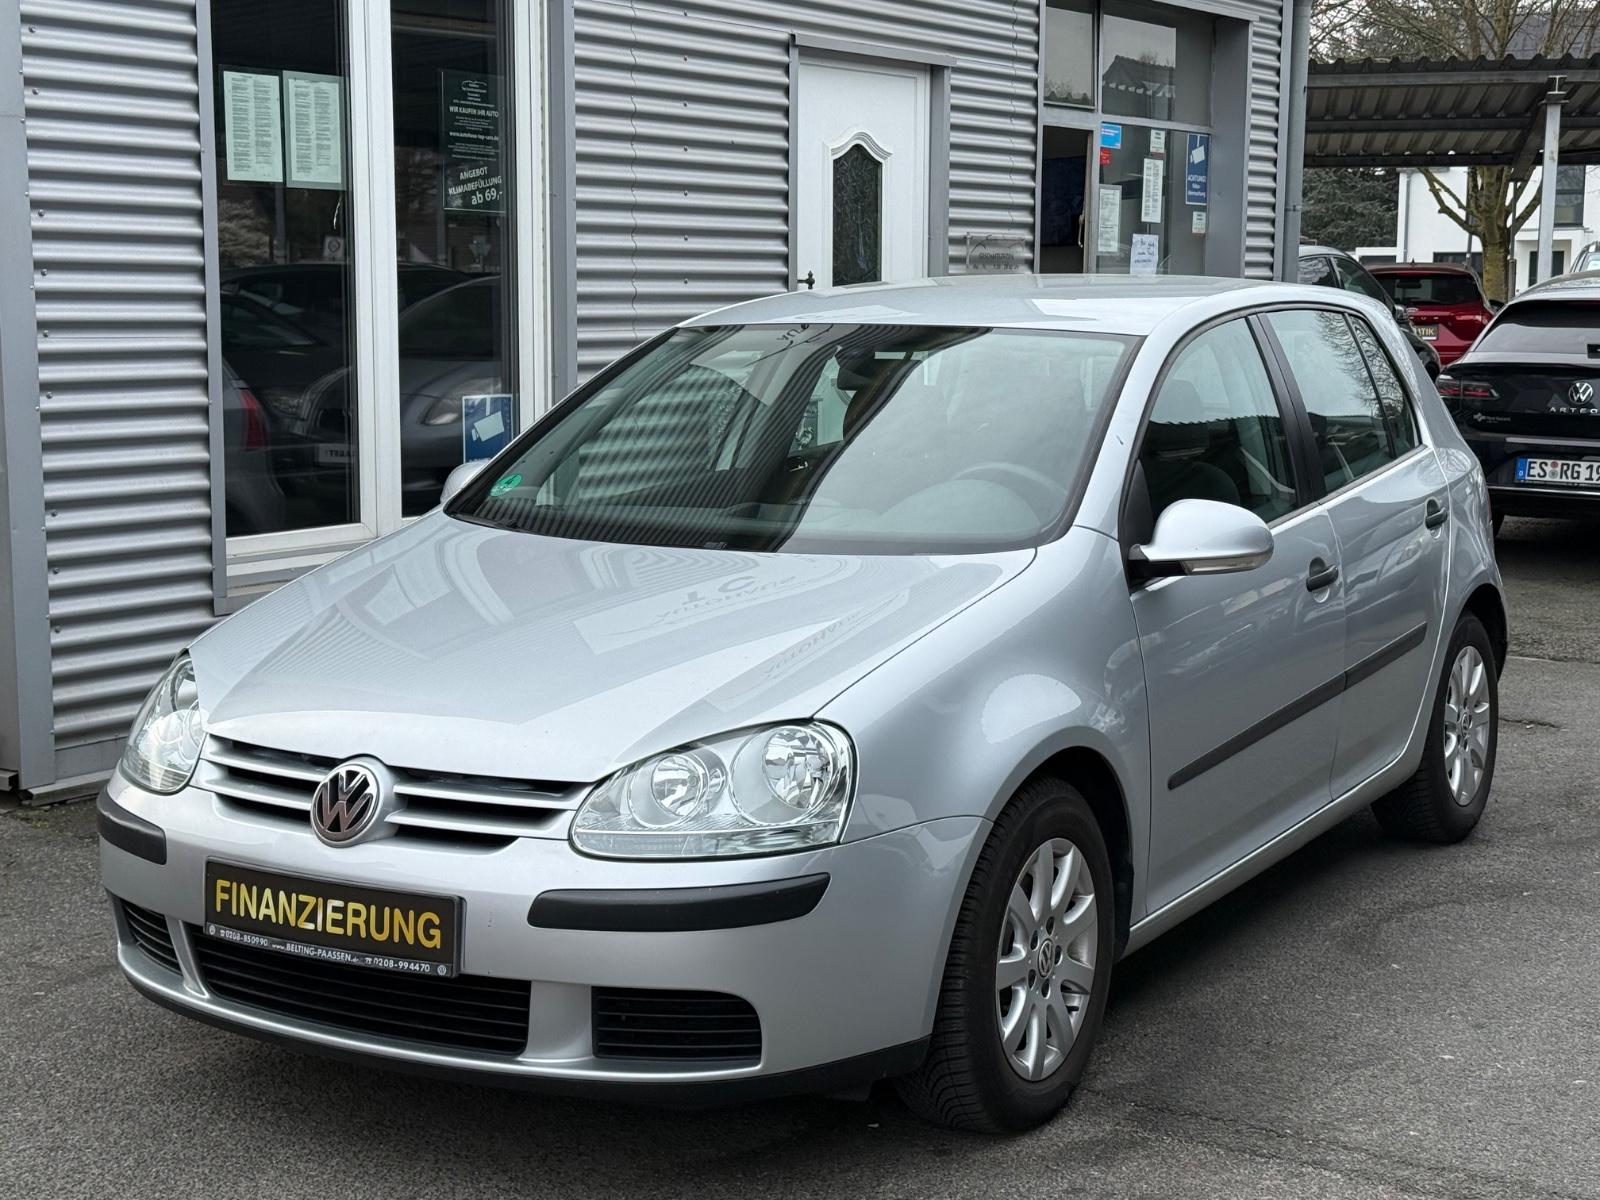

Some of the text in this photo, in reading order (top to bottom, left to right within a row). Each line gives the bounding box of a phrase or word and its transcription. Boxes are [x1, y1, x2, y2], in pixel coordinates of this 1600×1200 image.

[486, 110, 499, 118] AUTO
[459, 166, 488, 181] ANGEBOT
[448, 175, 502, 196] KLIMABEFÜLLUNG
[471, 190, 484, 205] ab
[1526, 460, 1549, 479] ES
[1559, 462, 1582, 481] RG
[215, 878, 442, 950] FINANZIERUNG
[373, 957, 431, 973] 0208-994470
